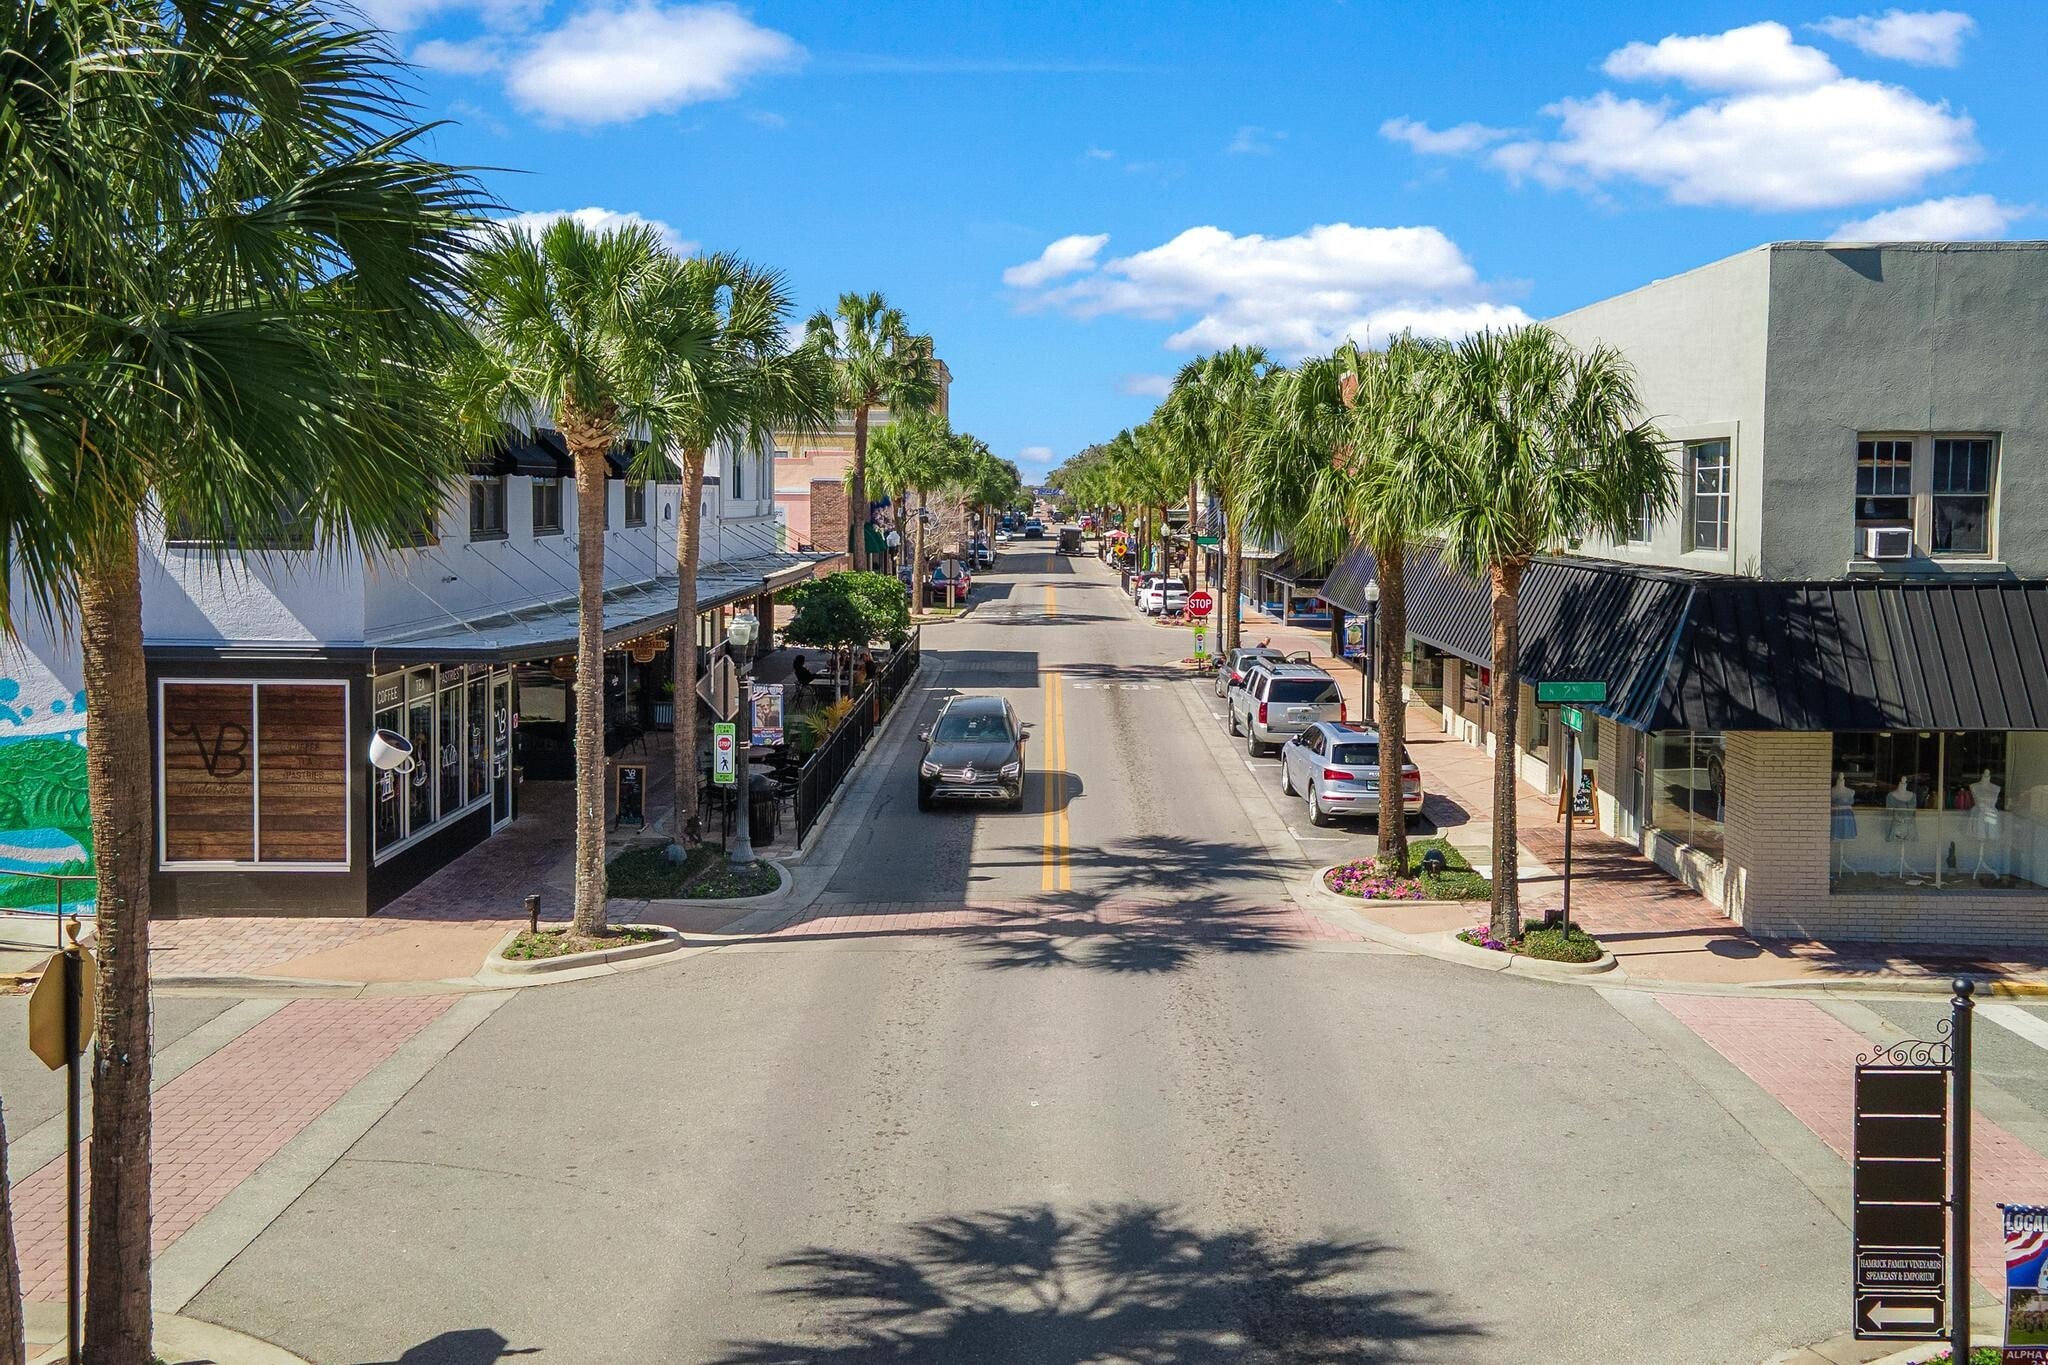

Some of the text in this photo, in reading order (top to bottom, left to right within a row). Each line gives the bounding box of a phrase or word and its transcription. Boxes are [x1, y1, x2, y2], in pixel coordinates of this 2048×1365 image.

[1190, 599, 1212, 608] STOP
[416, 678, 425, 692] TEA
[377, 686, 398, 704] COFFEE
[2005, 1213, 2048, 1232] LOCAL
[1860, 1259, 1942, 1270] HAMRICK FAMILY VINEYARDS
[1866, 1271, 1935, 1281] SPEAKEASY & EMPORIUM
[2007, 1350, 2044, 1359] ALPHA
